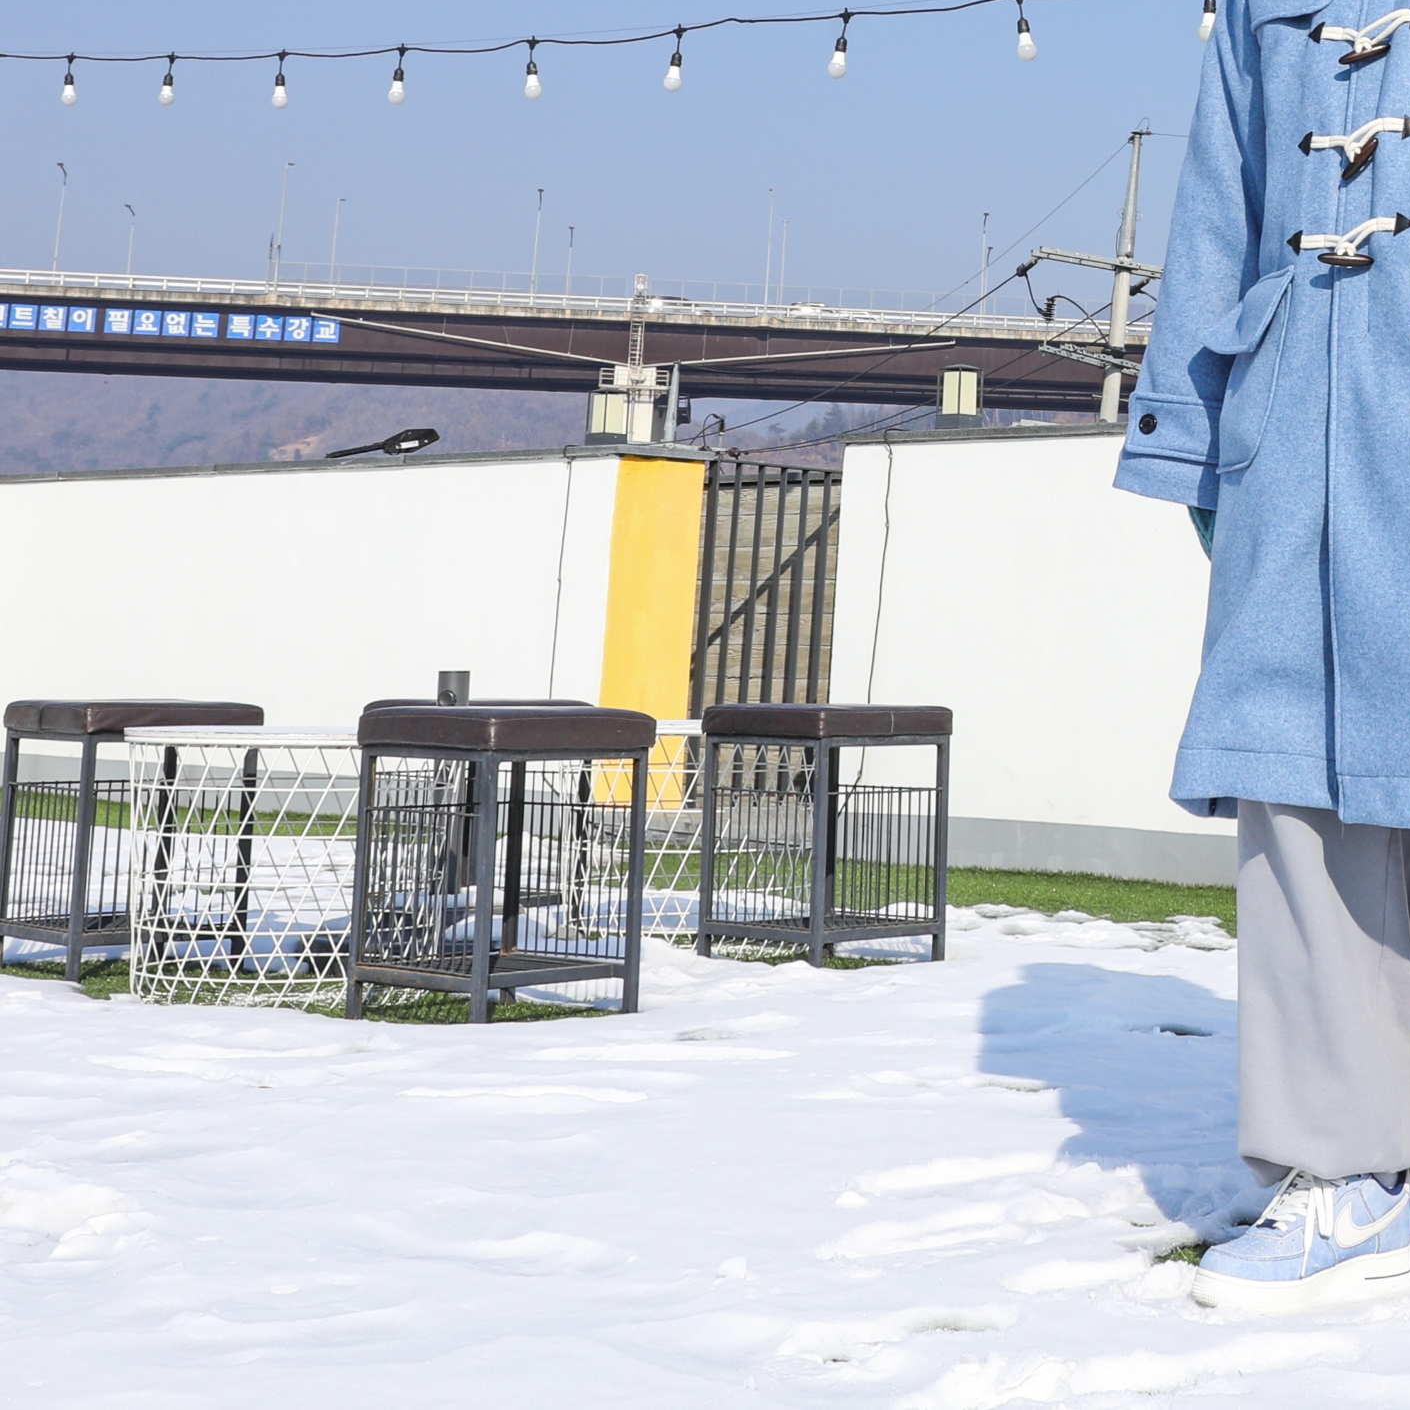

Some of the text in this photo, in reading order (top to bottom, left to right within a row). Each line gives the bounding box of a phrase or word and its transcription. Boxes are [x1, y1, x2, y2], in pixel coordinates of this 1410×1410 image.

[0, 305, 337, 340] 트칠이 필요없는 특수강교
